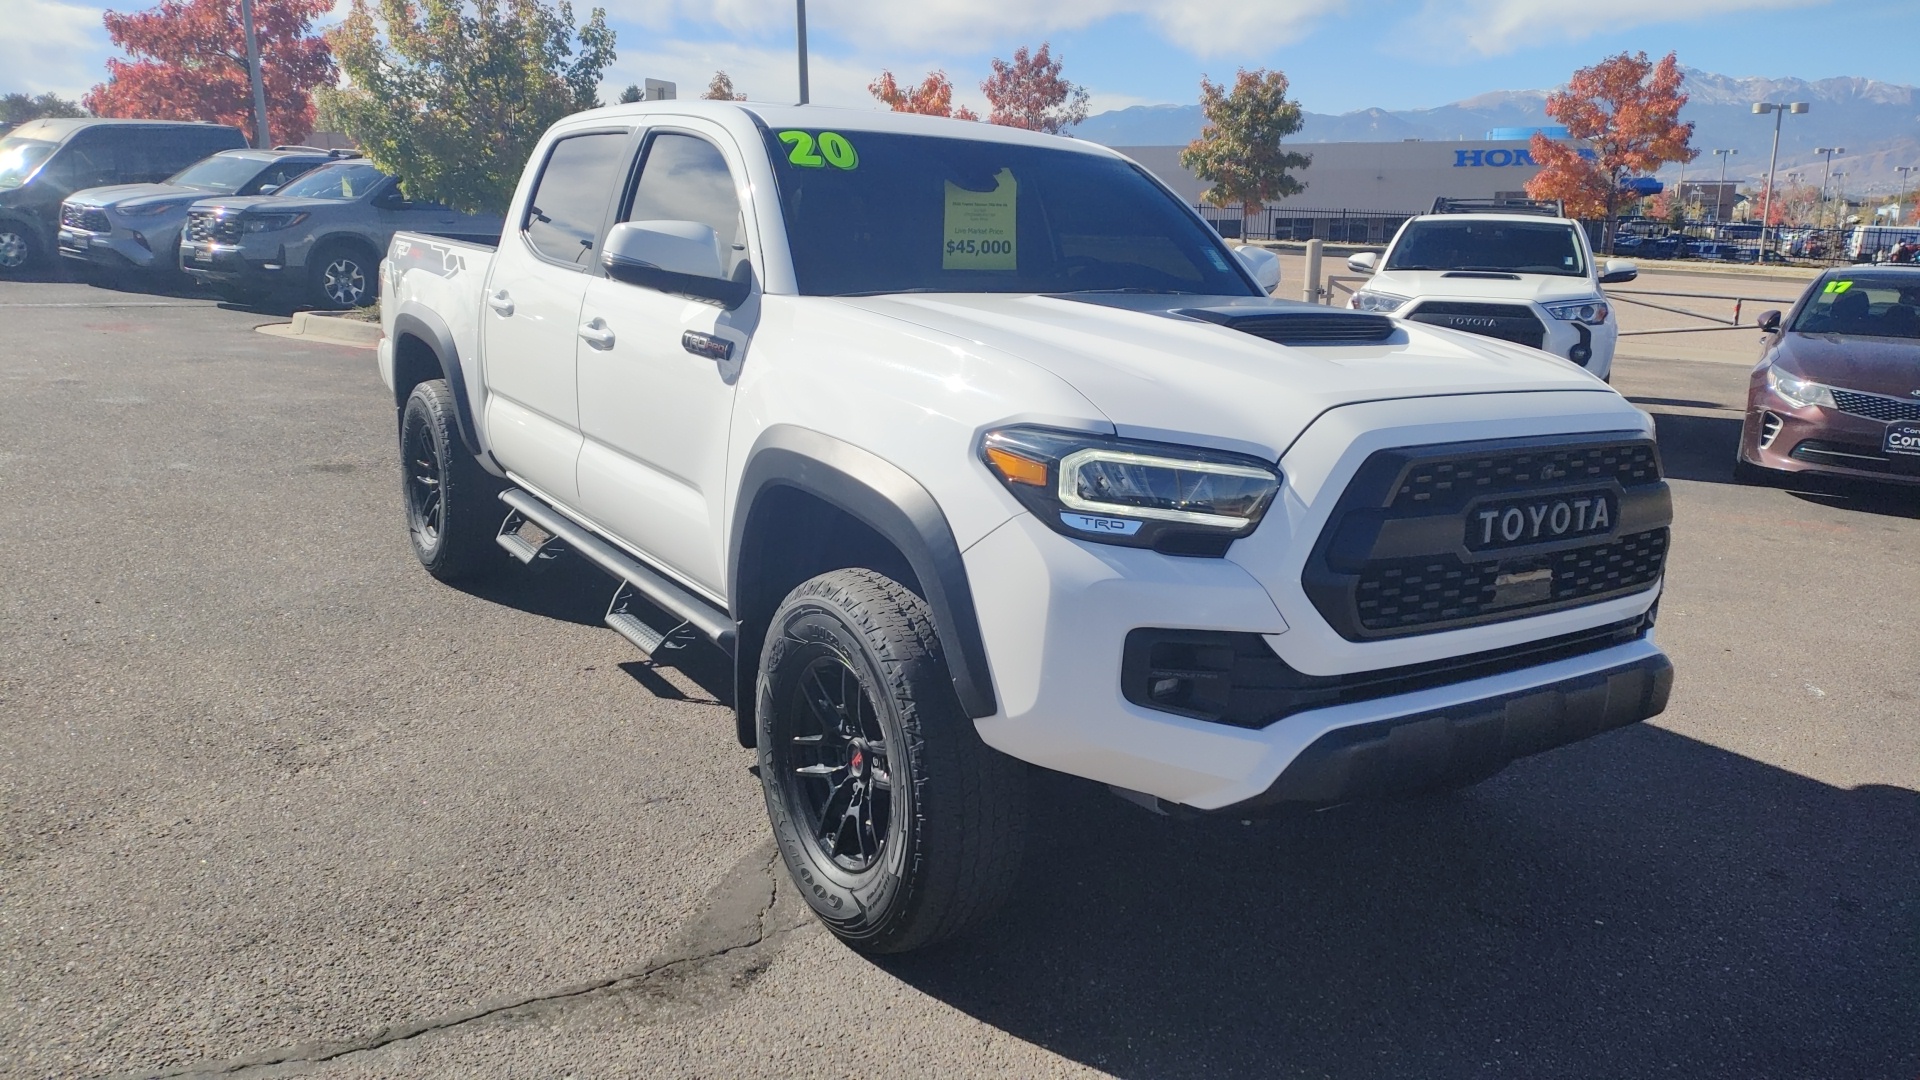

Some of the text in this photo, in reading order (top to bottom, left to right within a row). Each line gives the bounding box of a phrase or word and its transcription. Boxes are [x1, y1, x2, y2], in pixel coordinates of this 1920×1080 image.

[778, 130, 859, 171] 20
[954, 227, 1004, 236] Live Market Price
[946, 238, 1011, 257] $45,000
[1822, 280, 1854, 294] 17
[1448, 316, 1497, 327] TOYOTA
[684, 332, 708, 352] TRD
[1079, 516, 1125, 531] TRD
[1479, 497, 1610, 544] TOYOTA
